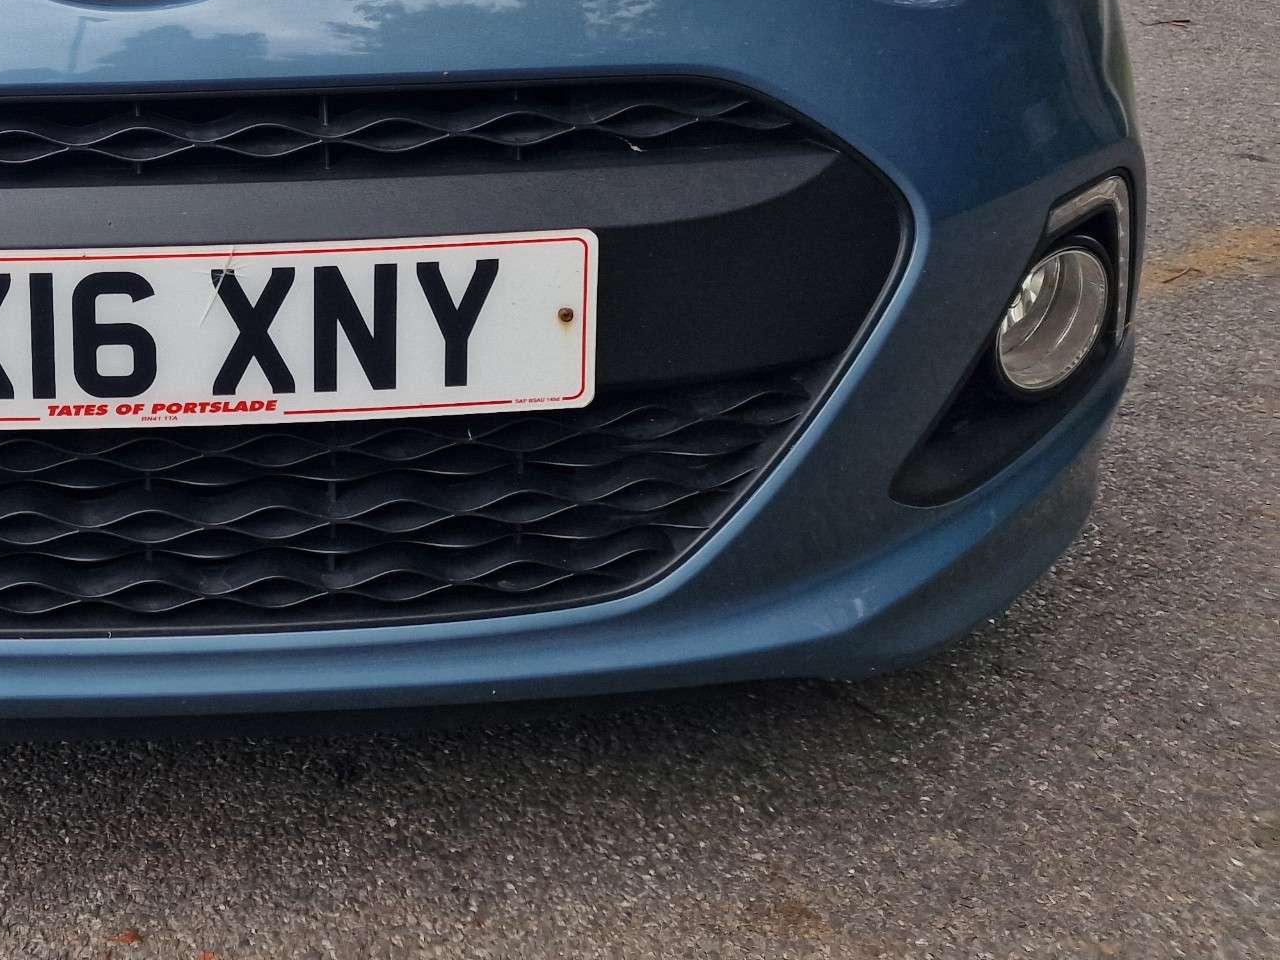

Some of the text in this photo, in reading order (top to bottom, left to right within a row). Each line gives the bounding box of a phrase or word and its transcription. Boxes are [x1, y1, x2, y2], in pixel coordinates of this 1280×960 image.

[210, 261, 500, 395] XNY
[47, 399, 278, 418] TATES OF PORTSLADE
